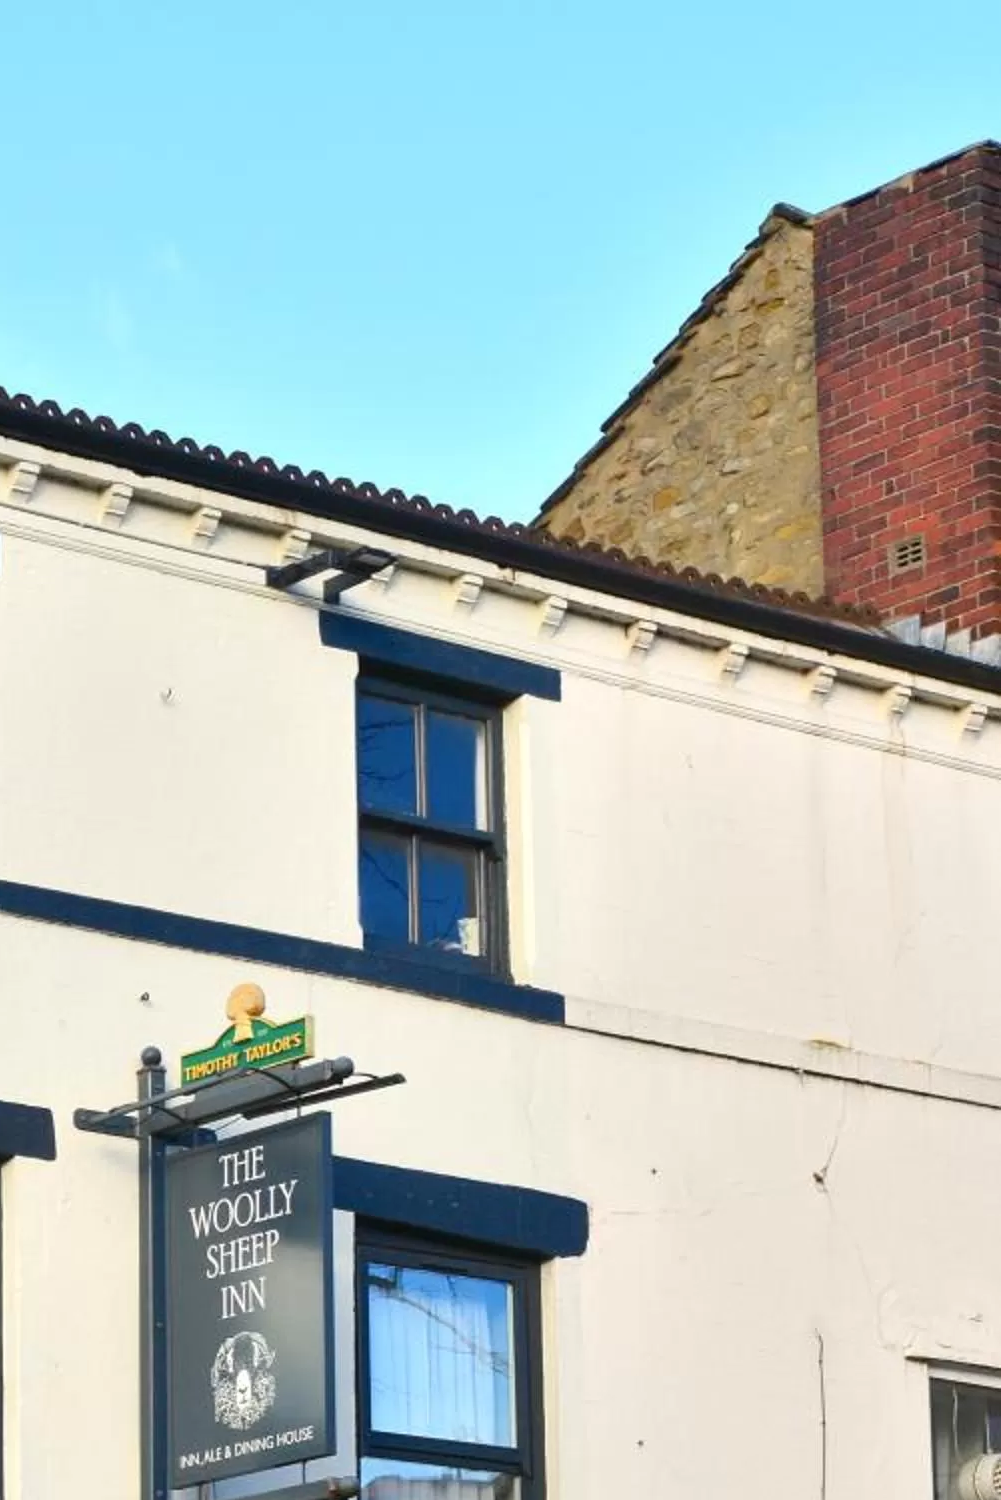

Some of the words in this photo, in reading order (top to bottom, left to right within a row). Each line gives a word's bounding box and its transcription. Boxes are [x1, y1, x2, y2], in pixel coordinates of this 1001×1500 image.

[184, 1052, 240, 1081] TIMOTHY
[245, 1032, 302, 1061] TAYLOR'S
[218, 1145, 266, 1187] THE
[188, 1179, 298, 1240] WOOLLY
[206, 1229, 280, 1279] SHEEP
[221, 1276, 267, 1319] INN
[204, 1447, 223, 1463] ALE
[224, 1446, 232, 1459] &
[234, 1436, 274, 1457] DINING
[276, 1425, 315, 1447] HOUSE
